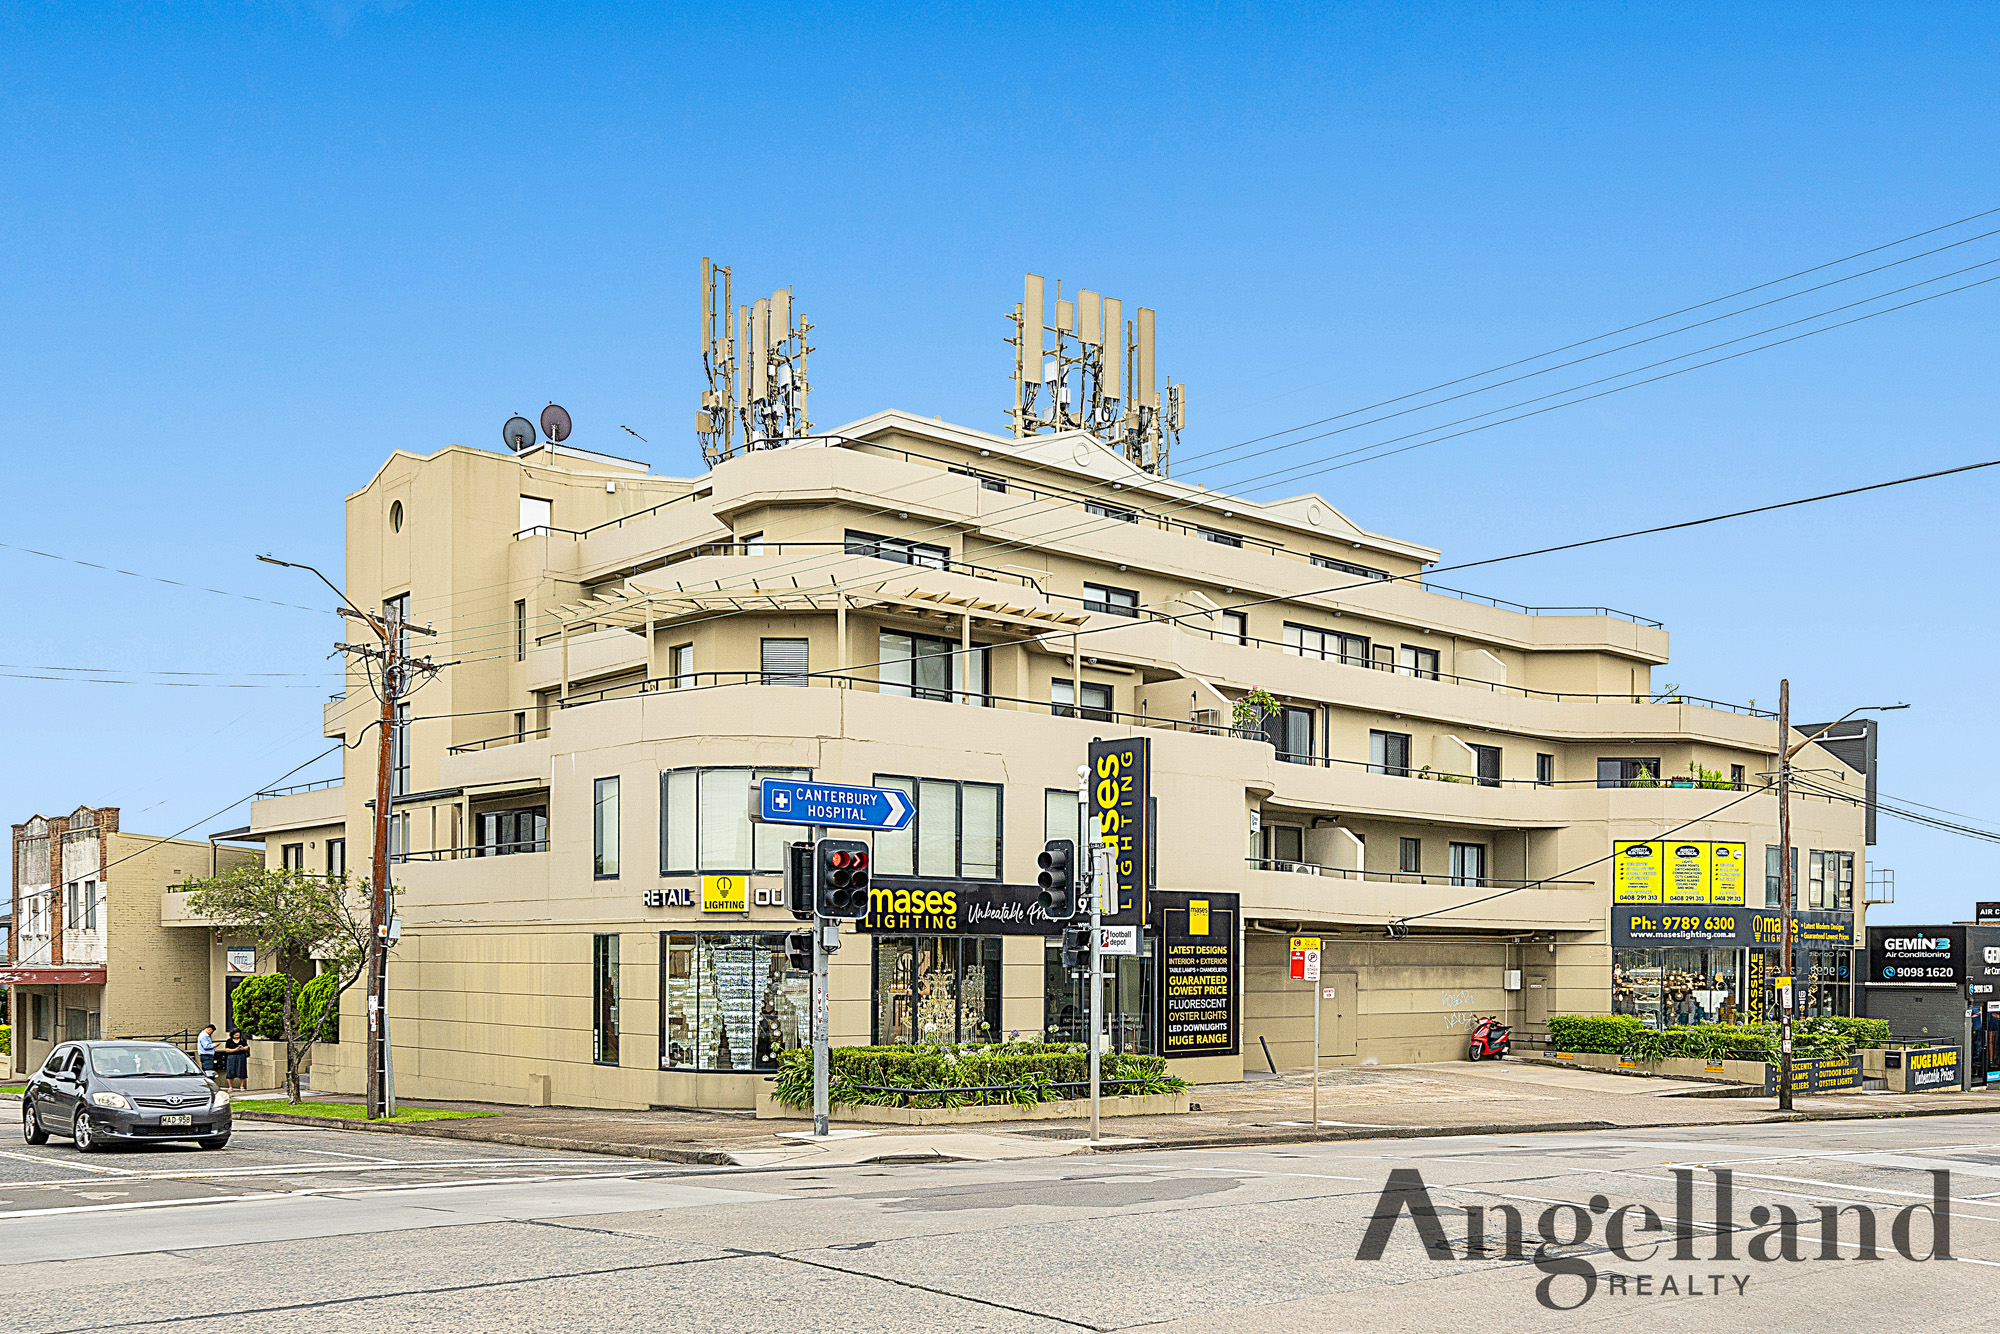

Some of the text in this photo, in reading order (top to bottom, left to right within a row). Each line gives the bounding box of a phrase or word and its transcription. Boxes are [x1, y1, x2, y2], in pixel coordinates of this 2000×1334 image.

[796, 788, 878, 806] CANTERBURY
[808, 805, 867, 821] HOSPITAL
[1096, 753, 1120, 910] ases
[1120, 751, 1133, 910] LIGHTING
[642, 889, 693, 907] RETAIL
[869, 888, 957, 914] mases
[704, 901, 745, 909] LIGHTING
[968, 901, 1024, 924] Unbeatable
[865, 914, 957, 930] LIGHTING
[1630, 916, 1735, 930] Ph: 9789 6300
[1763, 917, 1799, 934] mas
[1803, 922, 1845, 932] Latest Modern Designs
[1109, 930, 1132, 938] football
[1630, 931, 1736, 940] www.maseslighting.com.au
[1763, 934, 1799, 943] LIGHNG
[1803, 932, 1825, 940] Guaranteed
[1109, 938, 1127, 947] depot
[1169, 945, 1228, 955] LATEST DESIGNS
[1898, 951, 1951, 959] Conditioning
[1168, 957, 1196, 965] INTERIOR
[1200, 957, 1228, 965] EXTERIOR
[1896, 967, 1954, 977] 9098 1620
[1169, 975, 1228, 986] GUARANTEED
[1169, 986, 1228, 996] LOWEST PRICE
[1750, 953, 1759, 1025] MASSIVE
[1758, 987, 1764, 997] IN
[1169, 998, 1227, 1010] FLUORESCENT
[1169, 1010, 1228, 1021] OYSTER LIGHTS
[1169, 1023, 1228, 1032] LED DOWNLIGHTS
[1169, 1033, 1228, 1046] HUGE RANGE
[1819, 1059, 1849, 1069] DOWNLIGHTS
[1910, 1051, 1957, 1070] HUGE RANGE
[1791, 1072, 1809, 1081] LAMPS
[1819, 1069, 1841, 1078] OUTDOOR
[1842, 1067, 1859, 1076] LIGHTS
[1915, 1067, 1955, 1086] Unbeatable Prices
[1819, 1078, 1837, 1088] OYSTER
[1837, 1076, 1853, 1084] LIGHTS
